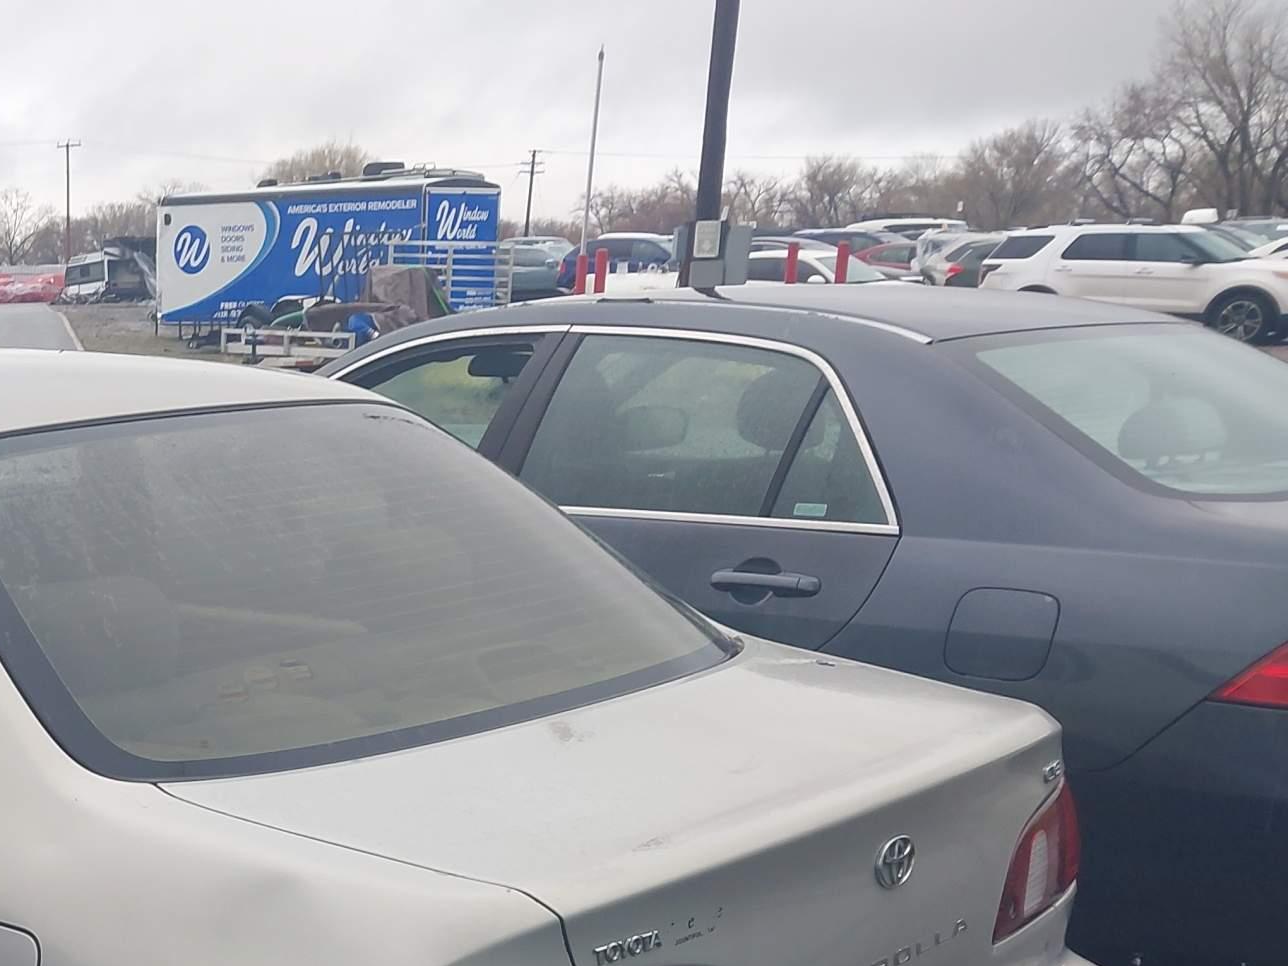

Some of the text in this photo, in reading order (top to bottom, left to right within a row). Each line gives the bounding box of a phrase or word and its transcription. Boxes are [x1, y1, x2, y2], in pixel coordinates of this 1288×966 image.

[288, 199, 418, 214] AMERICA'S EXTERIOR REMODELER
[220, 223, 255, 233] WINDOWS
[220, 234, 246, 244] DOORS
[226, 254, 246, 263] MORE
[593, 930, 662, 966] TOYOTA
